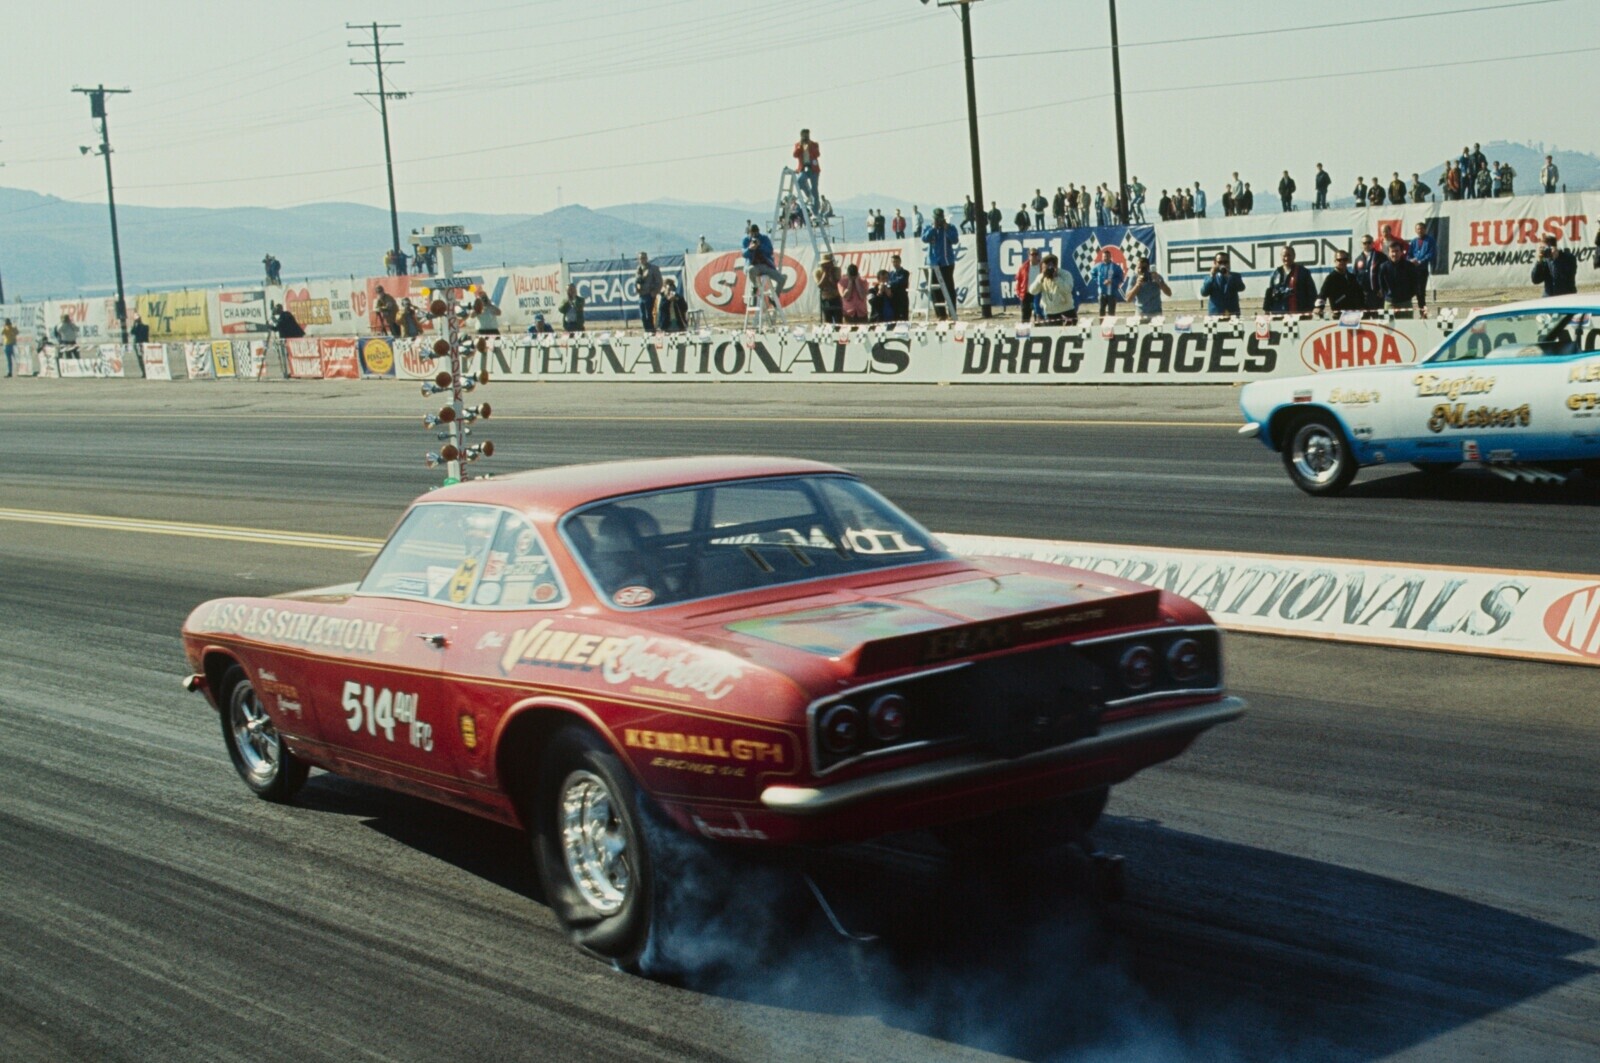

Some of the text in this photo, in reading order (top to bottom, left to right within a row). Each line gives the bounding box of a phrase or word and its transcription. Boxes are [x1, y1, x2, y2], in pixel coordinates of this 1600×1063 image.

[431, 234, 470, 246] STAGED
[1470, 214, 1588, 248] HURST
[1167, 236, 1353, 274] FENTON
[1452, 248, 1536, 271] PERFORMANCE
[434, 277, 473, 288] STAGED
[512, 271, 560, 296] VALVOLINE
[223, 307, 262, 319] CHAMPION
[519, 295, 556, 309] MOTOR OIL
[965, 333, 1086, 374] DRAG
[1103, 331, 1282, 374] RACES
[1312, 329, 1403, 370] NHRA
[616, 588, 655, 605] STP
[203, 602, 384, 652] ASSASSINATION
[500, 618, 629, 675] VINER
[341, 681, 396, 742] 514
[624, 728, 730, 758] KENDALL
